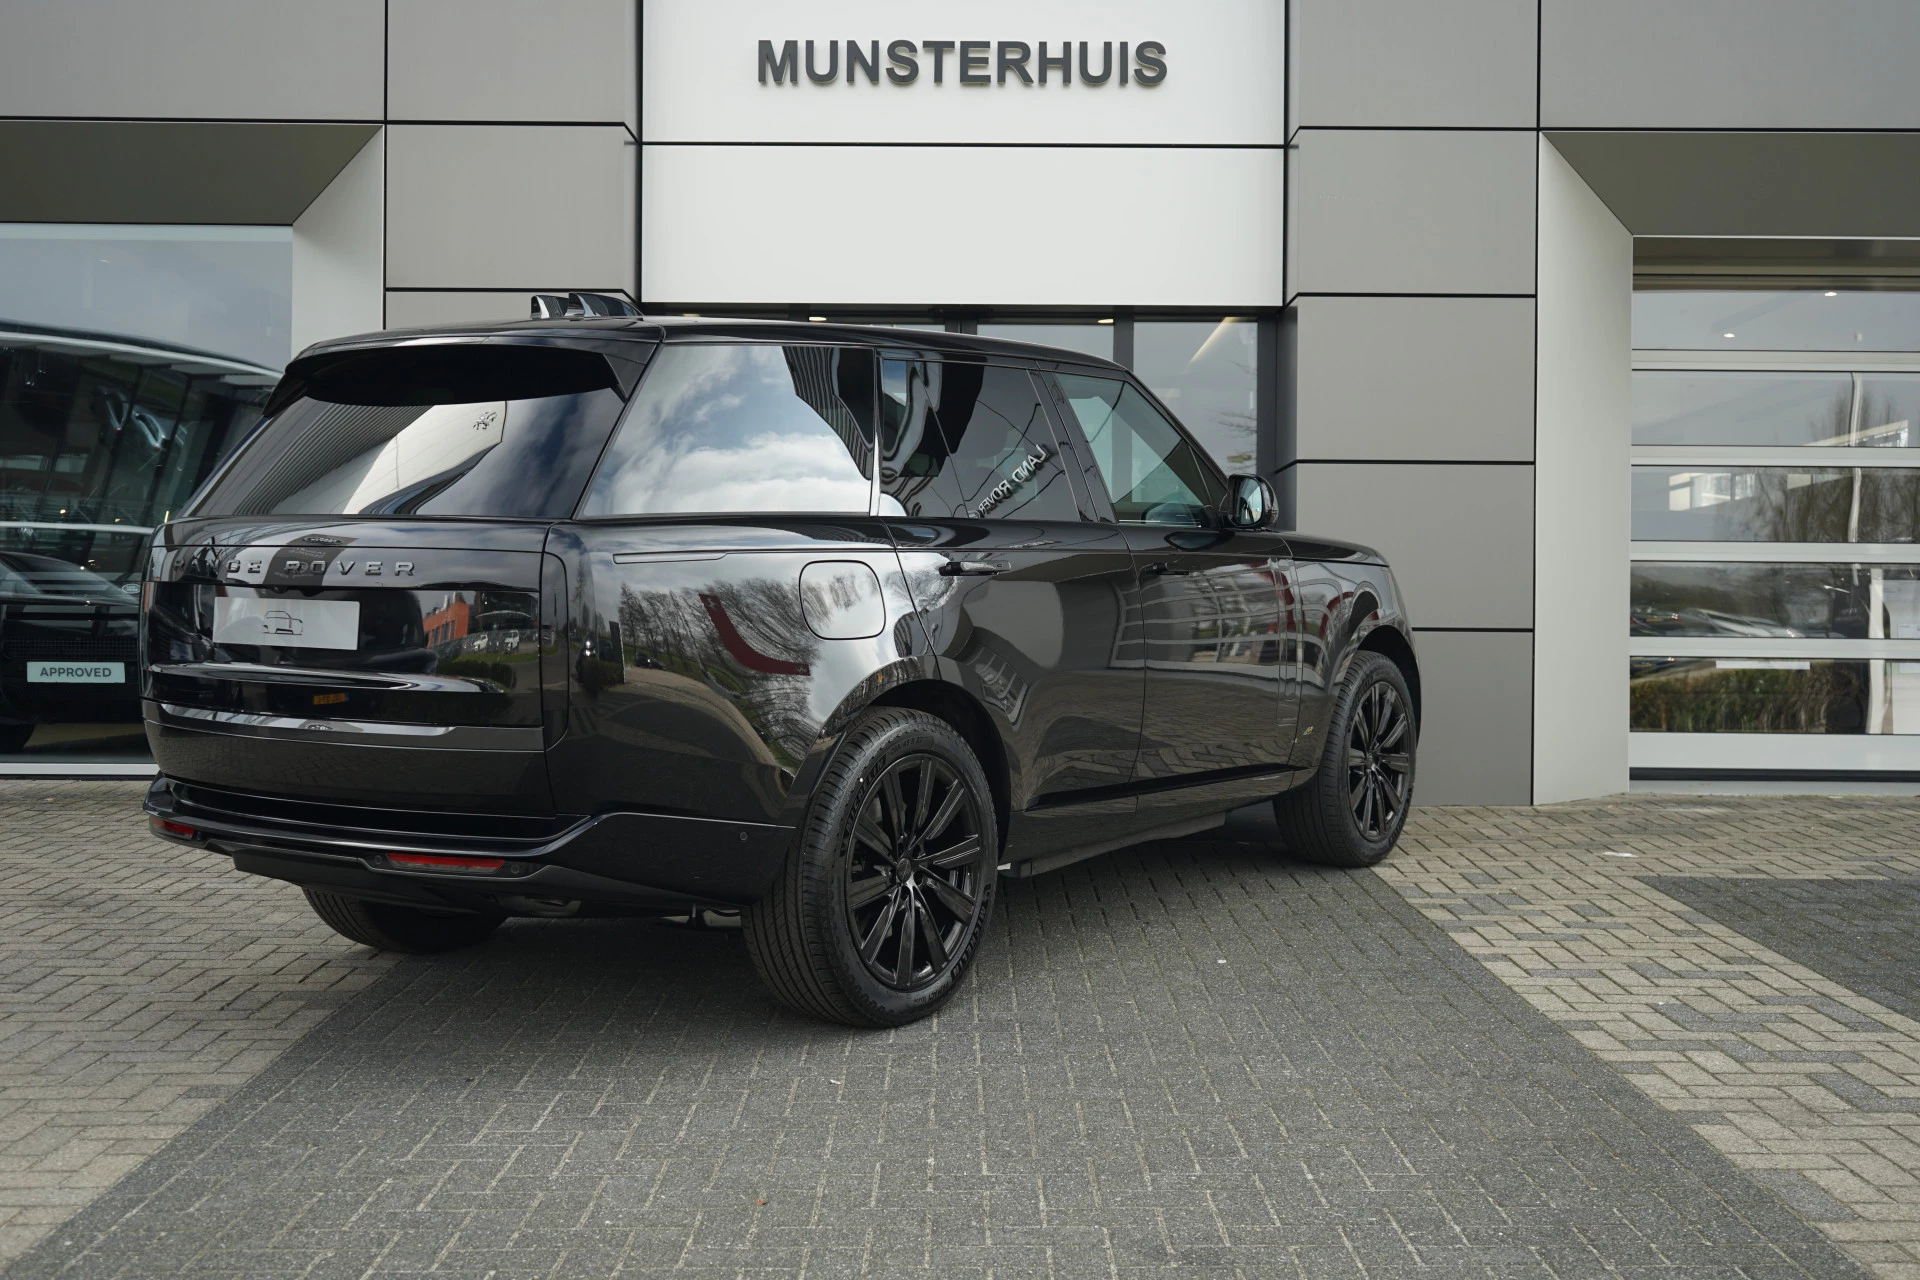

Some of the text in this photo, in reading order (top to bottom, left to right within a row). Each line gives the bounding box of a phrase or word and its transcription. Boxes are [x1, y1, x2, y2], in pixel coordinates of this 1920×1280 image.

[758, 40, 1168, 86] MUNSTERHUIS
[286, 561, 414, 576] ROVER
[40, 667, 112, 678] APPROVED
